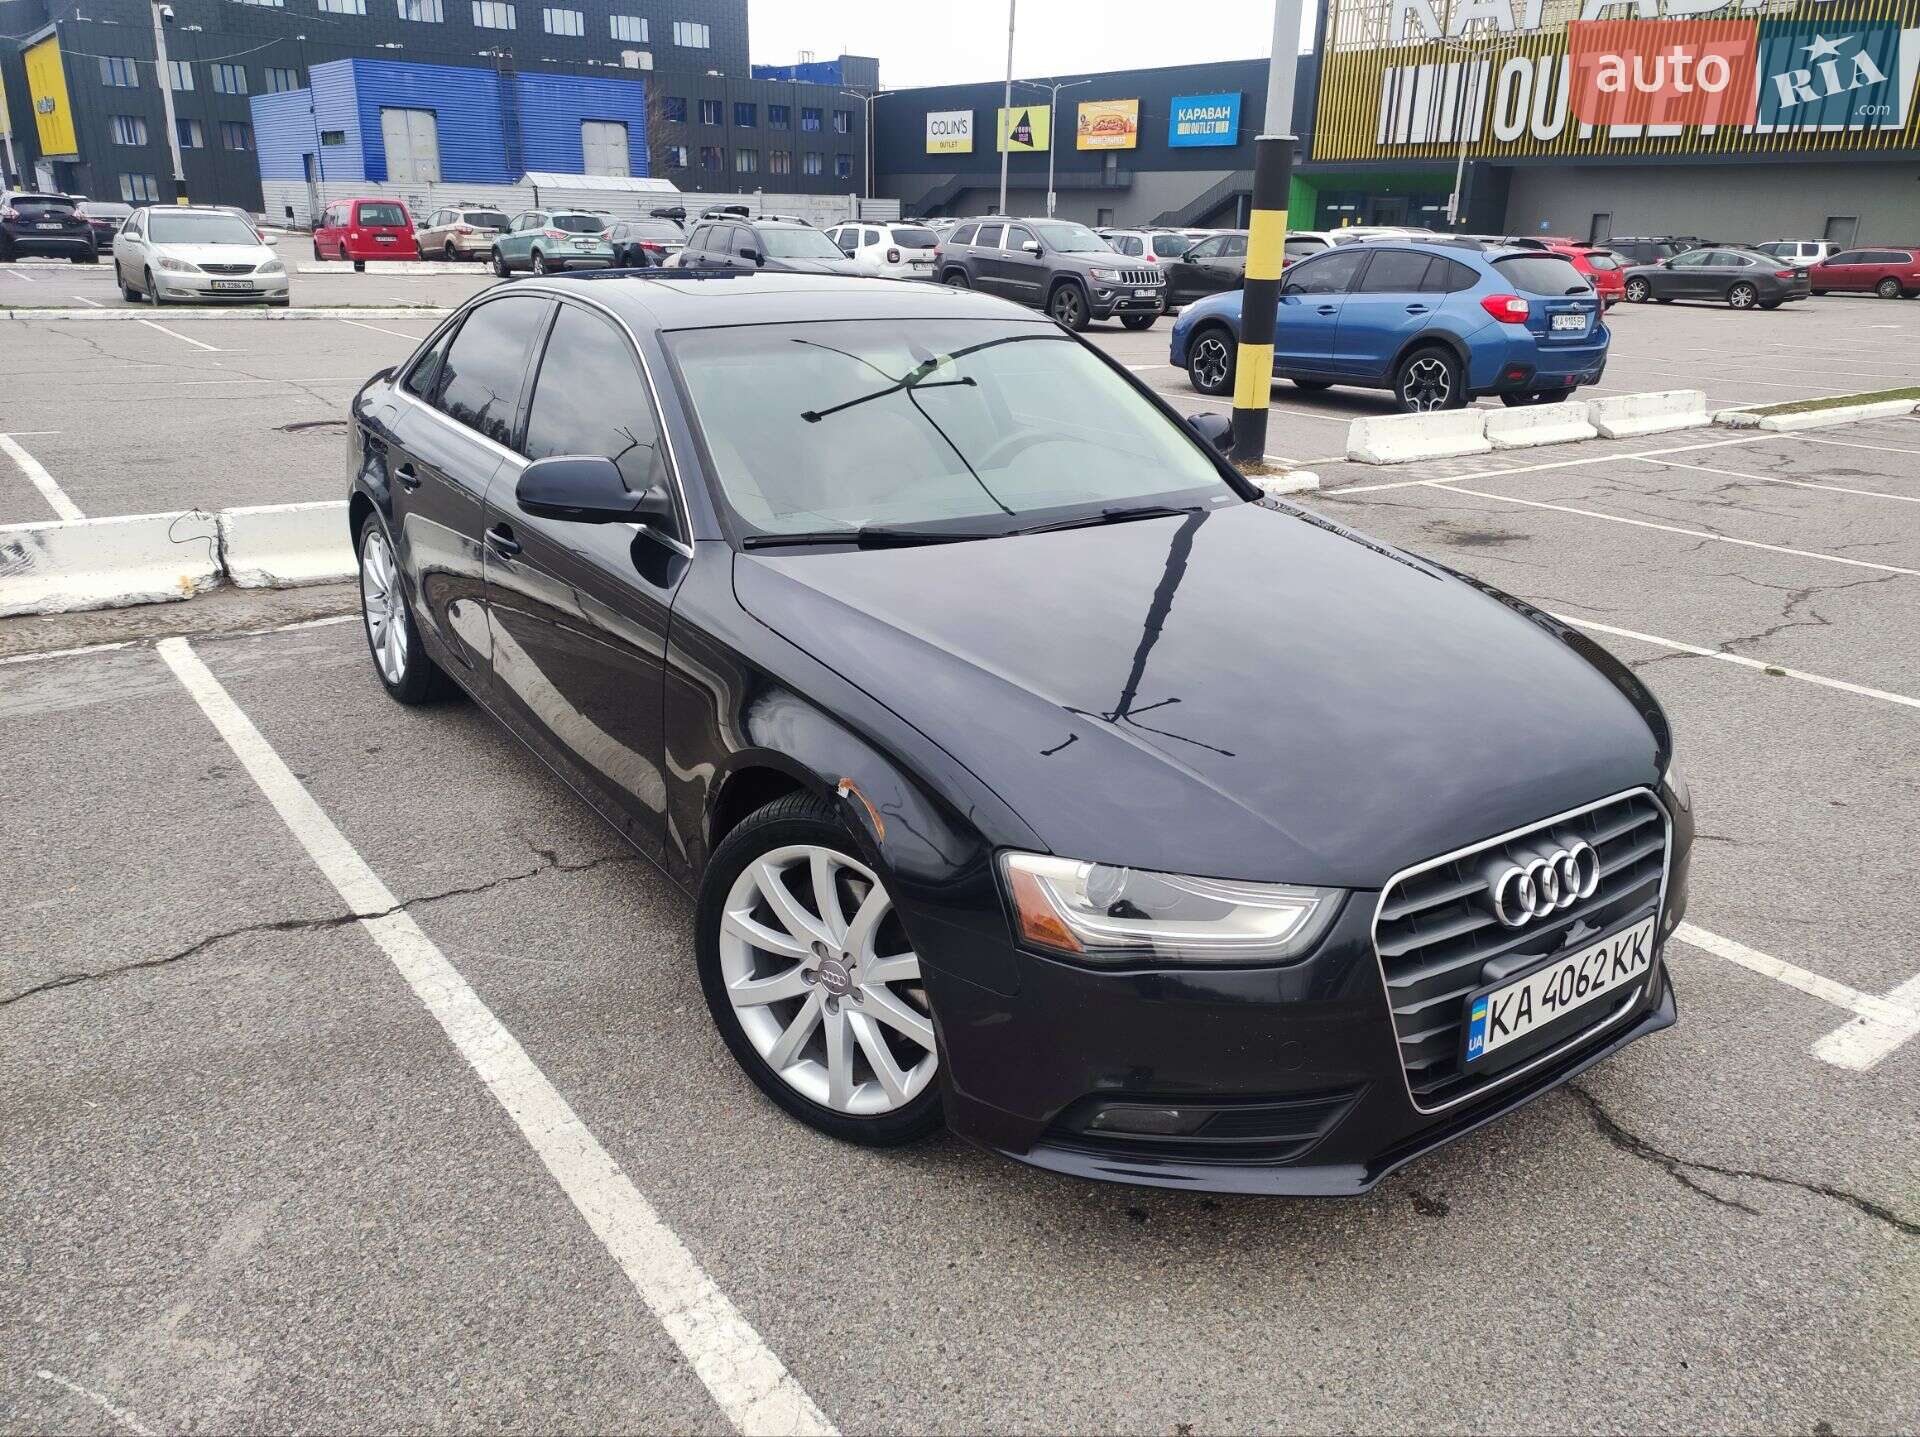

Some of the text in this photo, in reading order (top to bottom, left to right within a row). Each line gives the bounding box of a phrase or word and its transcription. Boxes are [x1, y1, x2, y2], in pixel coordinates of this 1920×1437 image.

[1178, 106, 1231, 121] КАРАВАН
[931, 118, 968, 135] COLIN'S
[1190, 121, 1216, 134] OUTLET
[939, 141, 958, 149] OUTLET
[1489, 924, 1651, 1042] KA 4062 KK
[1469, 1034, 1483, 1051] UA
